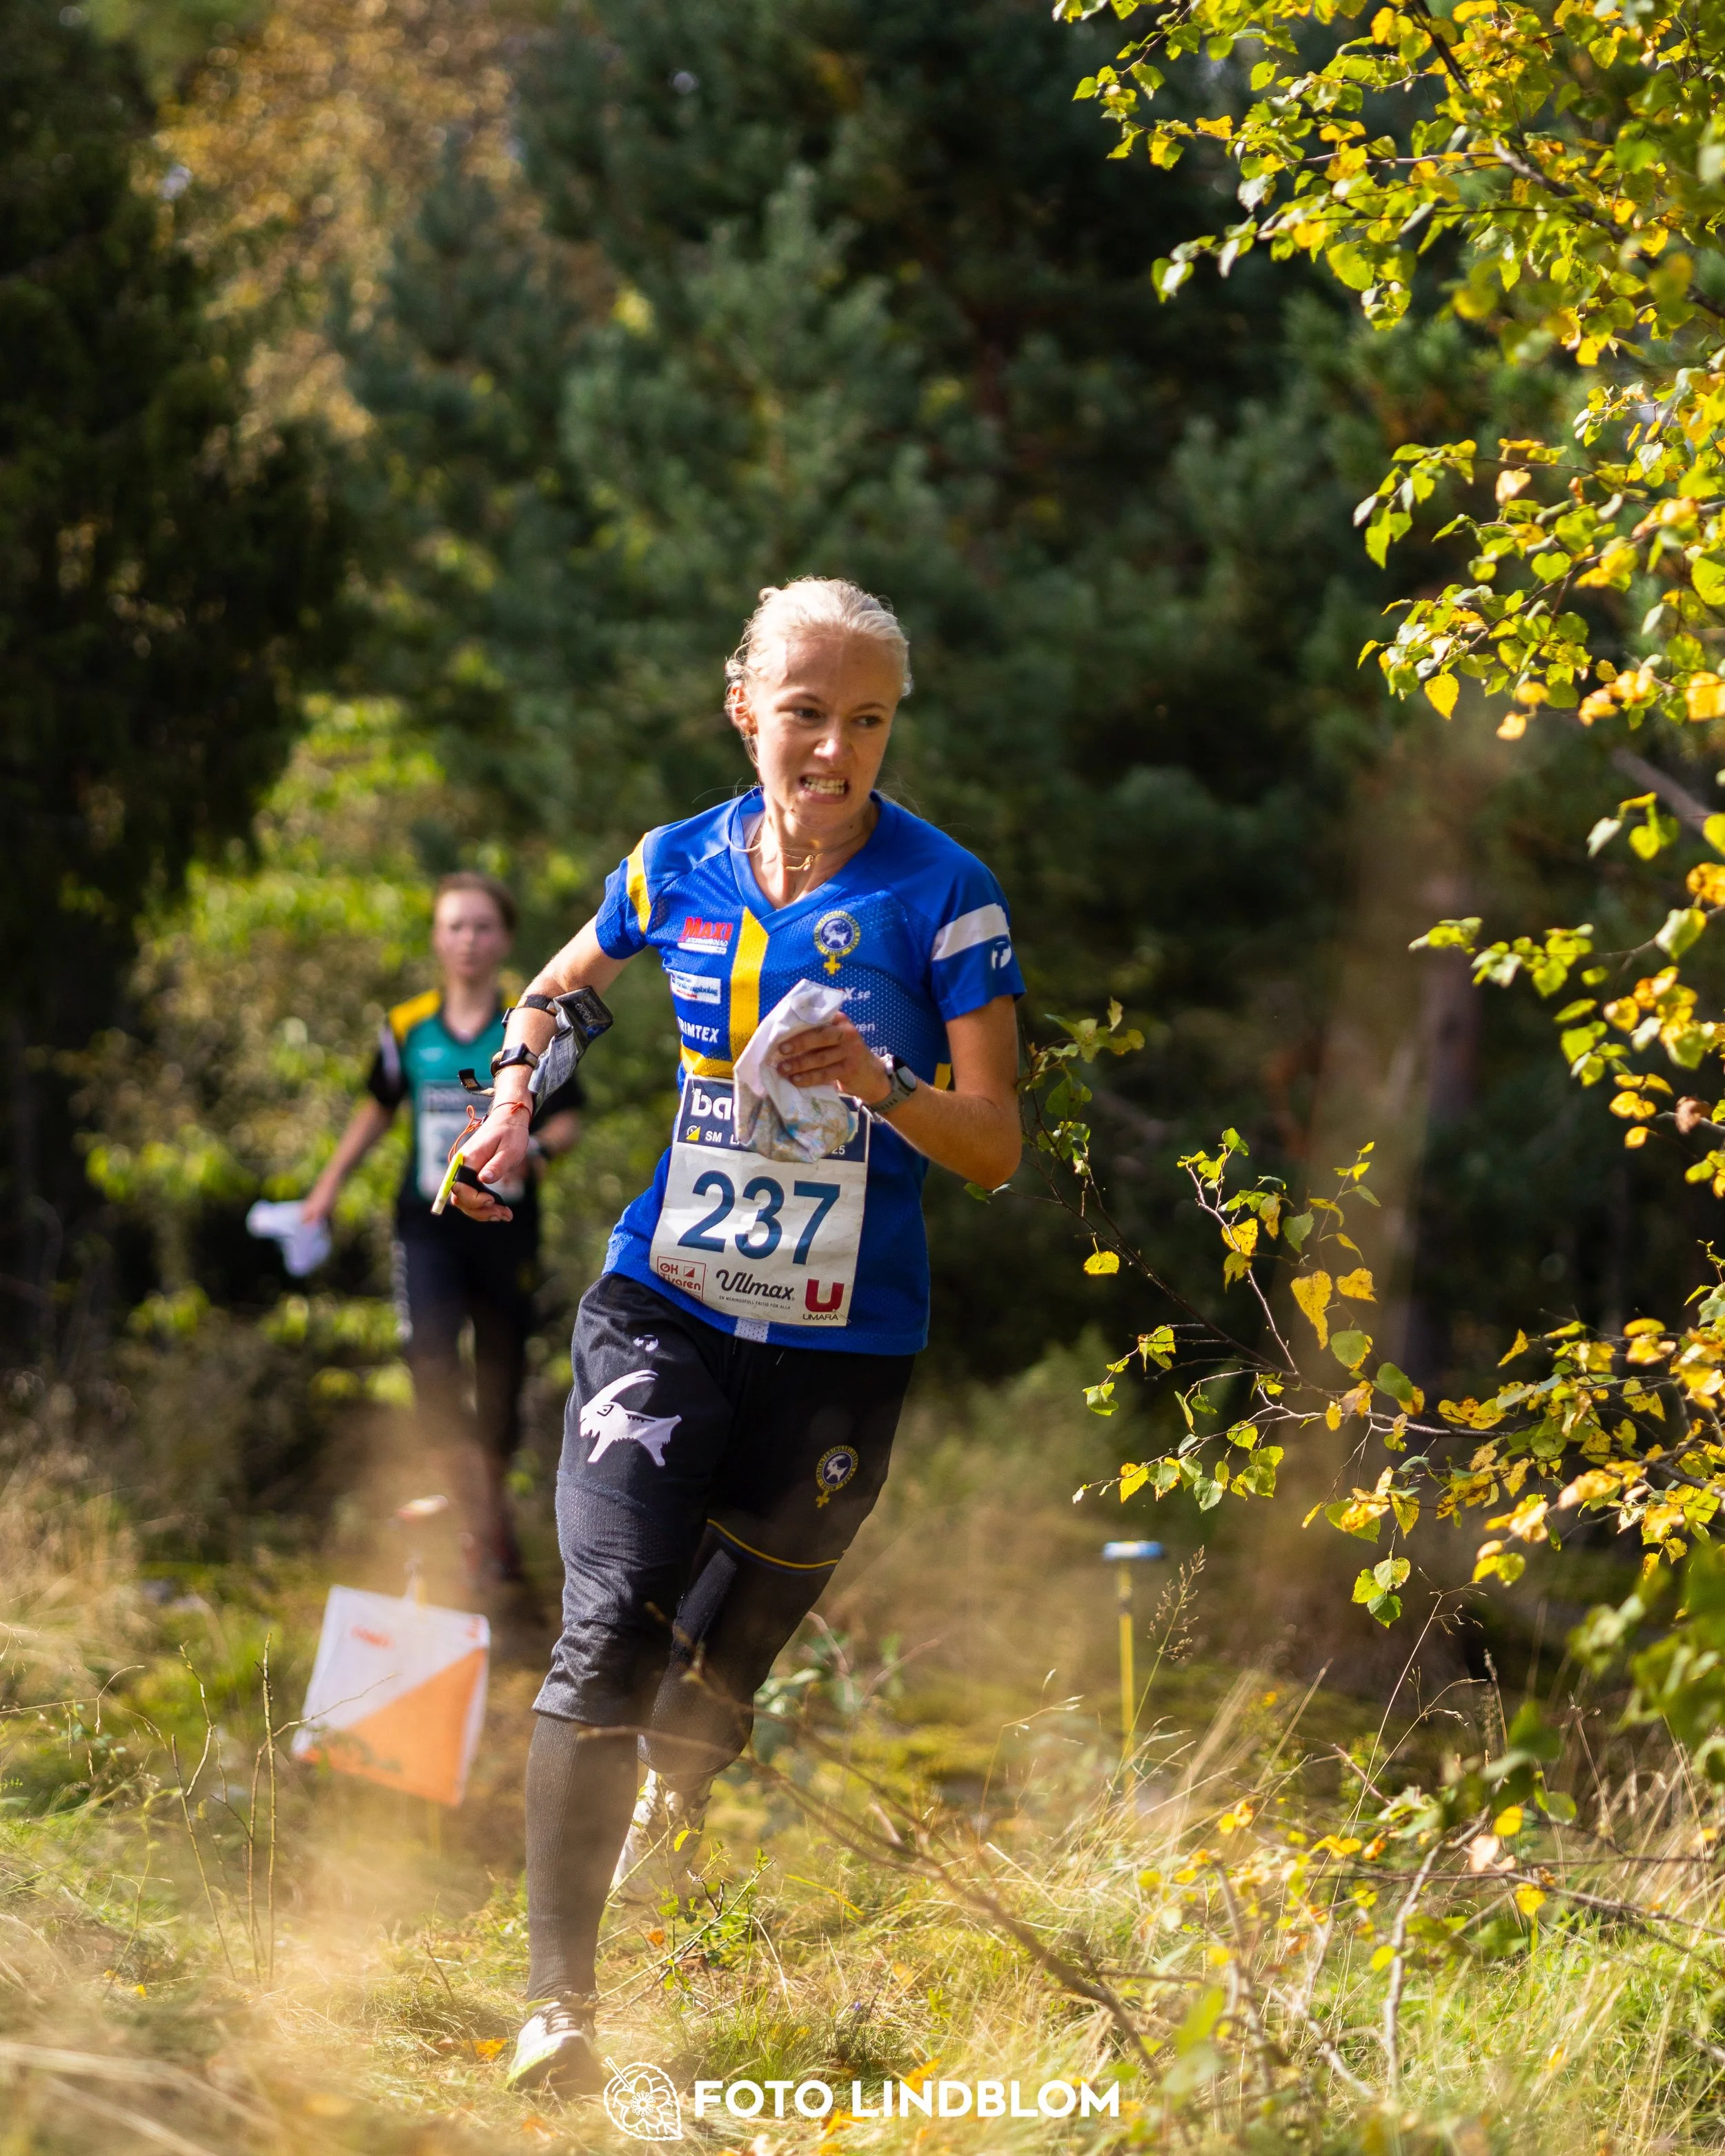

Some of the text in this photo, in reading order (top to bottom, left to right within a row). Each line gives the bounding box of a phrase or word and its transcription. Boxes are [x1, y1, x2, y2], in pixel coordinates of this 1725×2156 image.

[678, 1016, 720, 1043] RIMTEX
[691, 1088, 738, 1120] ba
[704, 1130, 722, 1143] SM
[729, 1134, 740, 1145] L
[678, 1170, 841, 1265] 237
[716, 1269, 795, 1300] Ullmax
